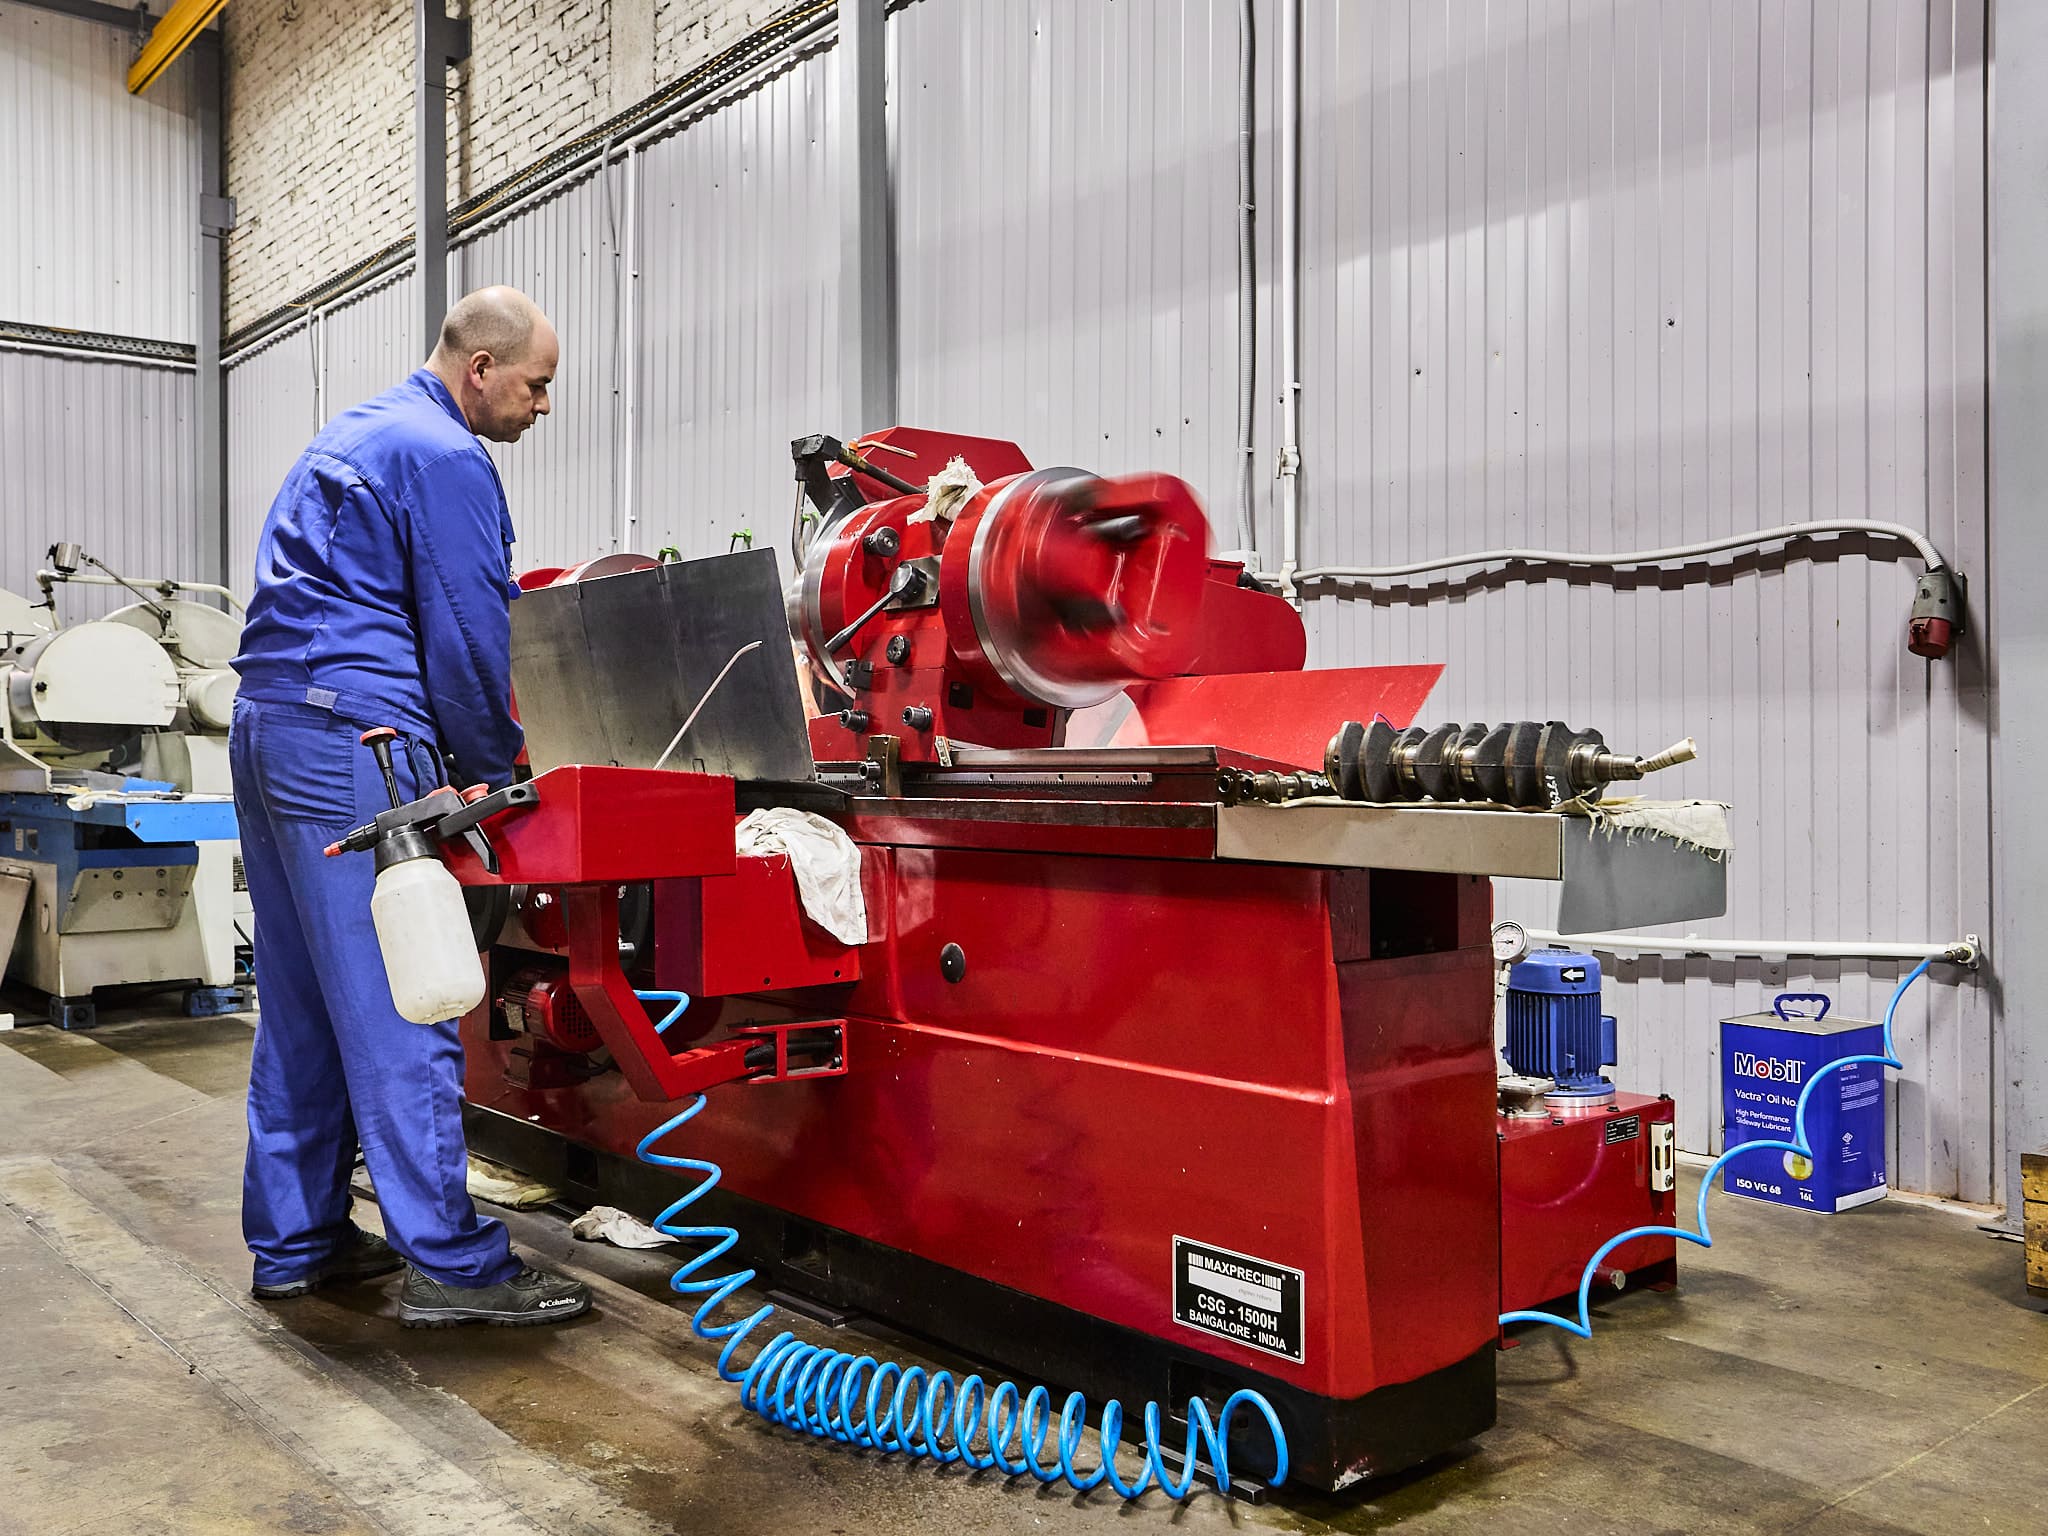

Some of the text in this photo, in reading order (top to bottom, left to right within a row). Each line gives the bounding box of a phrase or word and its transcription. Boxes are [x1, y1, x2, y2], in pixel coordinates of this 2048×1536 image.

[1735, 1052, 1801, 1083] Mobil
[1767, 1094, 1780, 1104] Oil
[1736, 1108, 1790, 1124] High Performance
[1736, 1116, 1792, 1133] Slideway Lubricant
[1736, 1178, 1781, 1195] ISO VG 68
[1800, 1191, 1815, 1203] 16L
[1204, 1257, 1265, 1286] MAXPRECI
[546, 1298, 576, 1307] Columbia
[1198, 1293, 1226, 1315] CSG
[1238, 1305, 1278, 1332] 1500H
[1189, 1309, 1251, 1339] BANGALORE
[1258, 1331, 1287, 1351] INDIA
